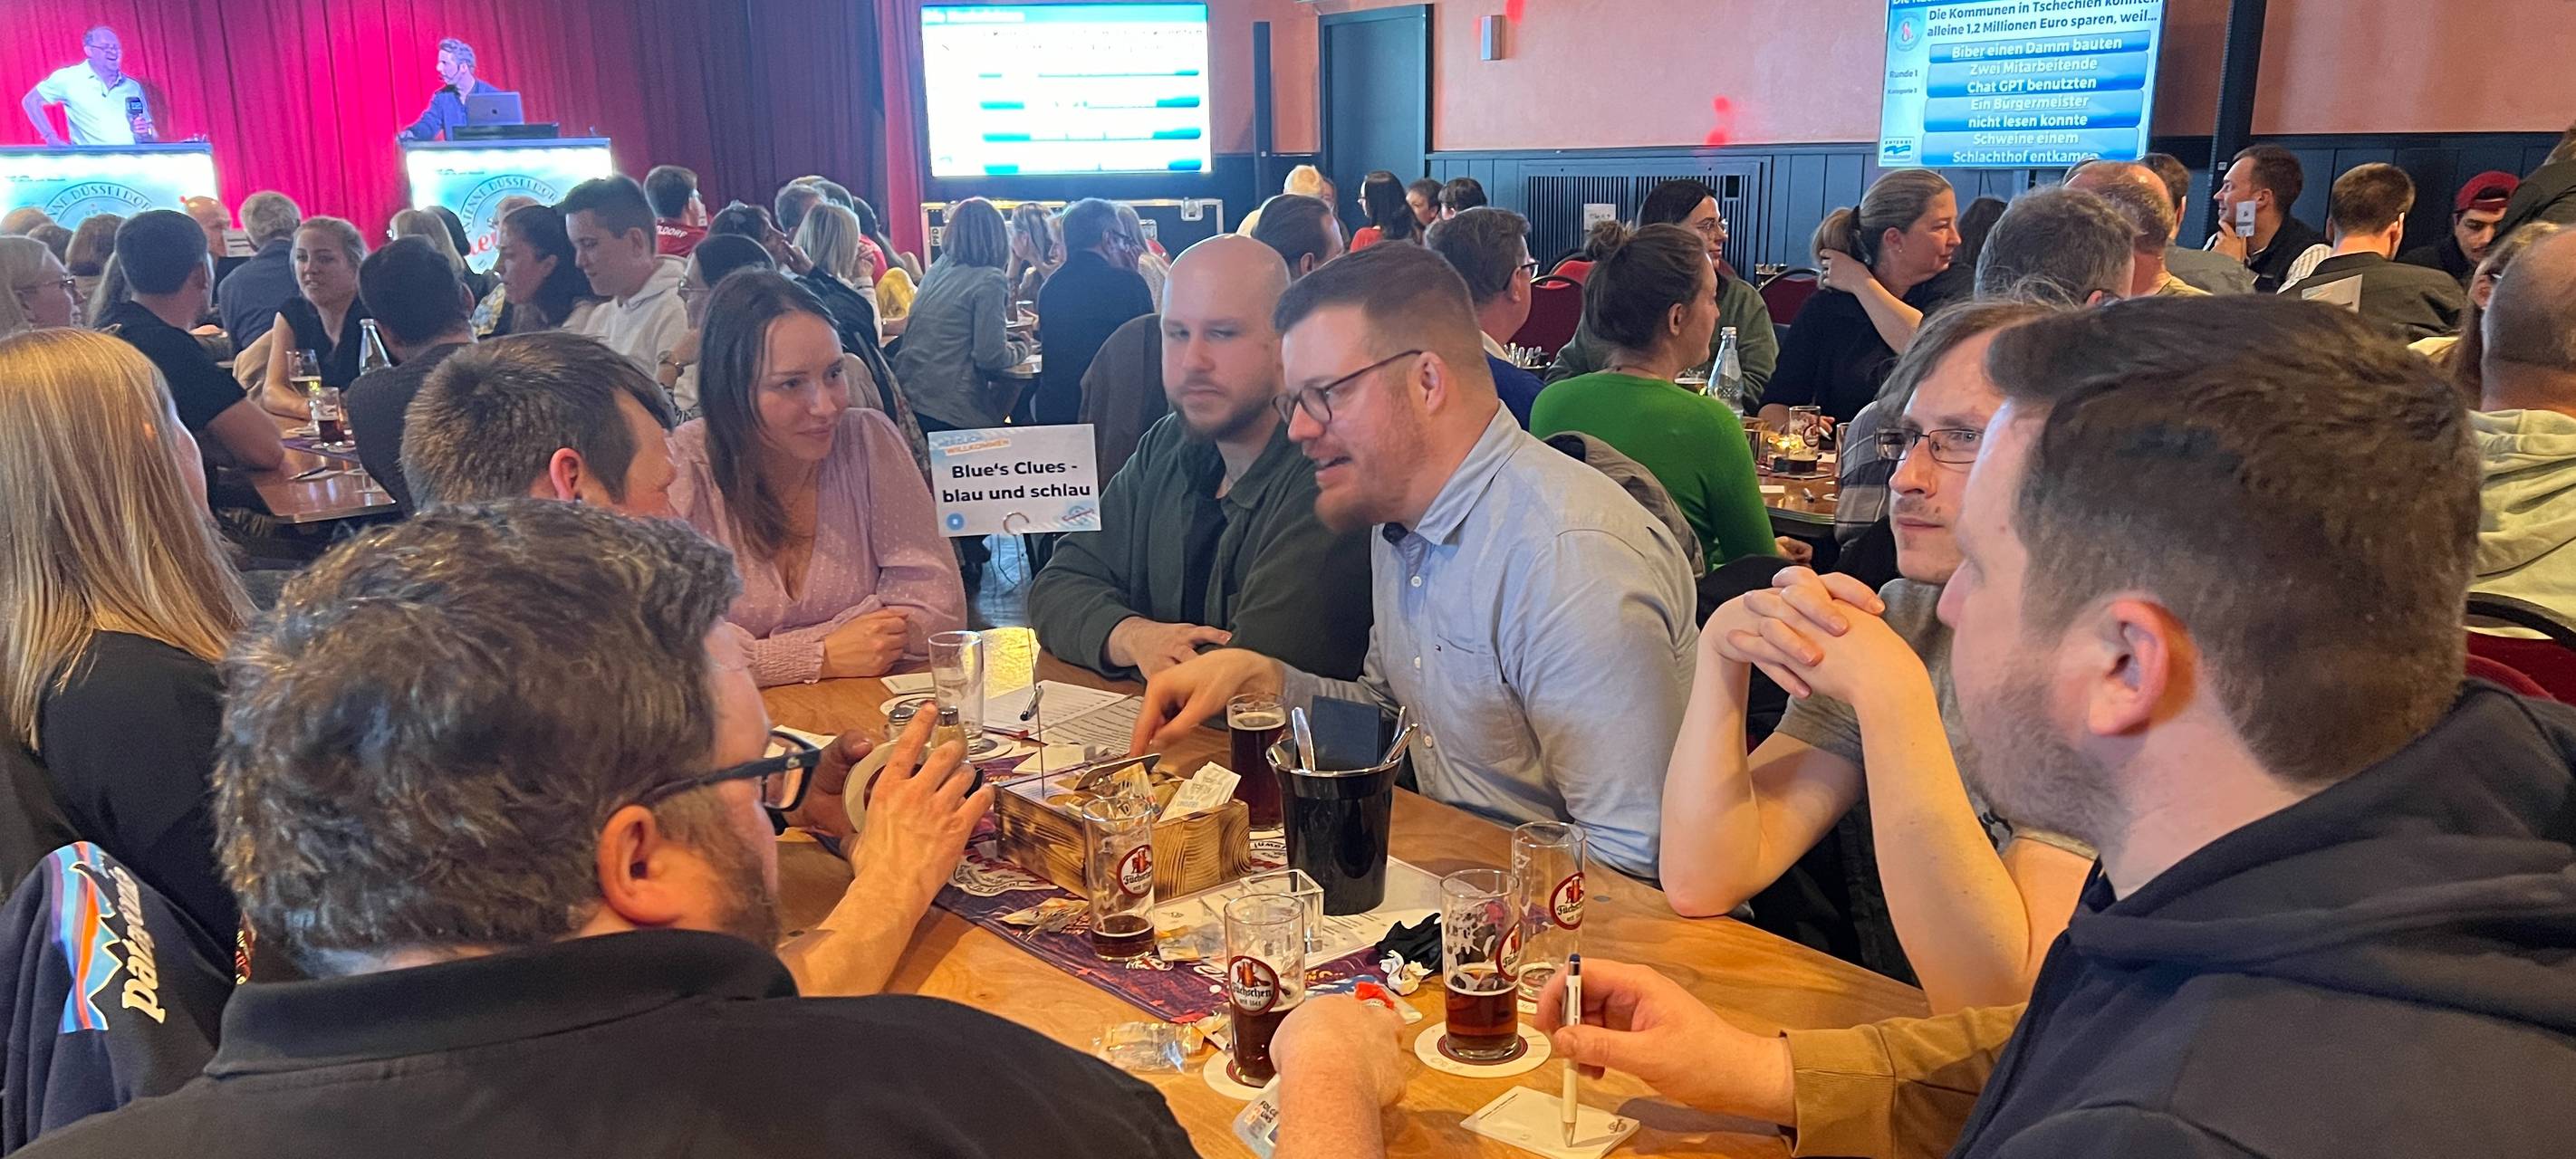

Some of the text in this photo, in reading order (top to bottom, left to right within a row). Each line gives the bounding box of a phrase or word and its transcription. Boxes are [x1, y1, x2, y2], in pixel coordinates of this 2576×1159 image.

[1929, 9, 1946, 21] Die
[1949, 5, 2015, 19] Kommunen
[2018, 3, 2029, 14] in
[2033, 0, 2101, 12] Tschechien
[1927, 9, 2158, 36] alleine 1,2 Millionen Euro sparen, weil...
[1952, 38, 2122, 59] Biber einen Damm bauten
[1970, 58, 2098, 75] Zwei Mitarbeitende
[1967, 77, 2097, 93] Chat GPT benutzten
[1971, 99, 1991, 110] Ein
[1967, 114, 2088, 129] nicht lesen konnte
[1973, 132, 2079, 145] Schweine einem
[1952, 150, 2030, 163] Schlachthof
[70, 184, 153, 211] DÜSSELDOR
[1014, 461, 1066, 475] Clues
[942, 483, 1091, 503] blau und schlau
